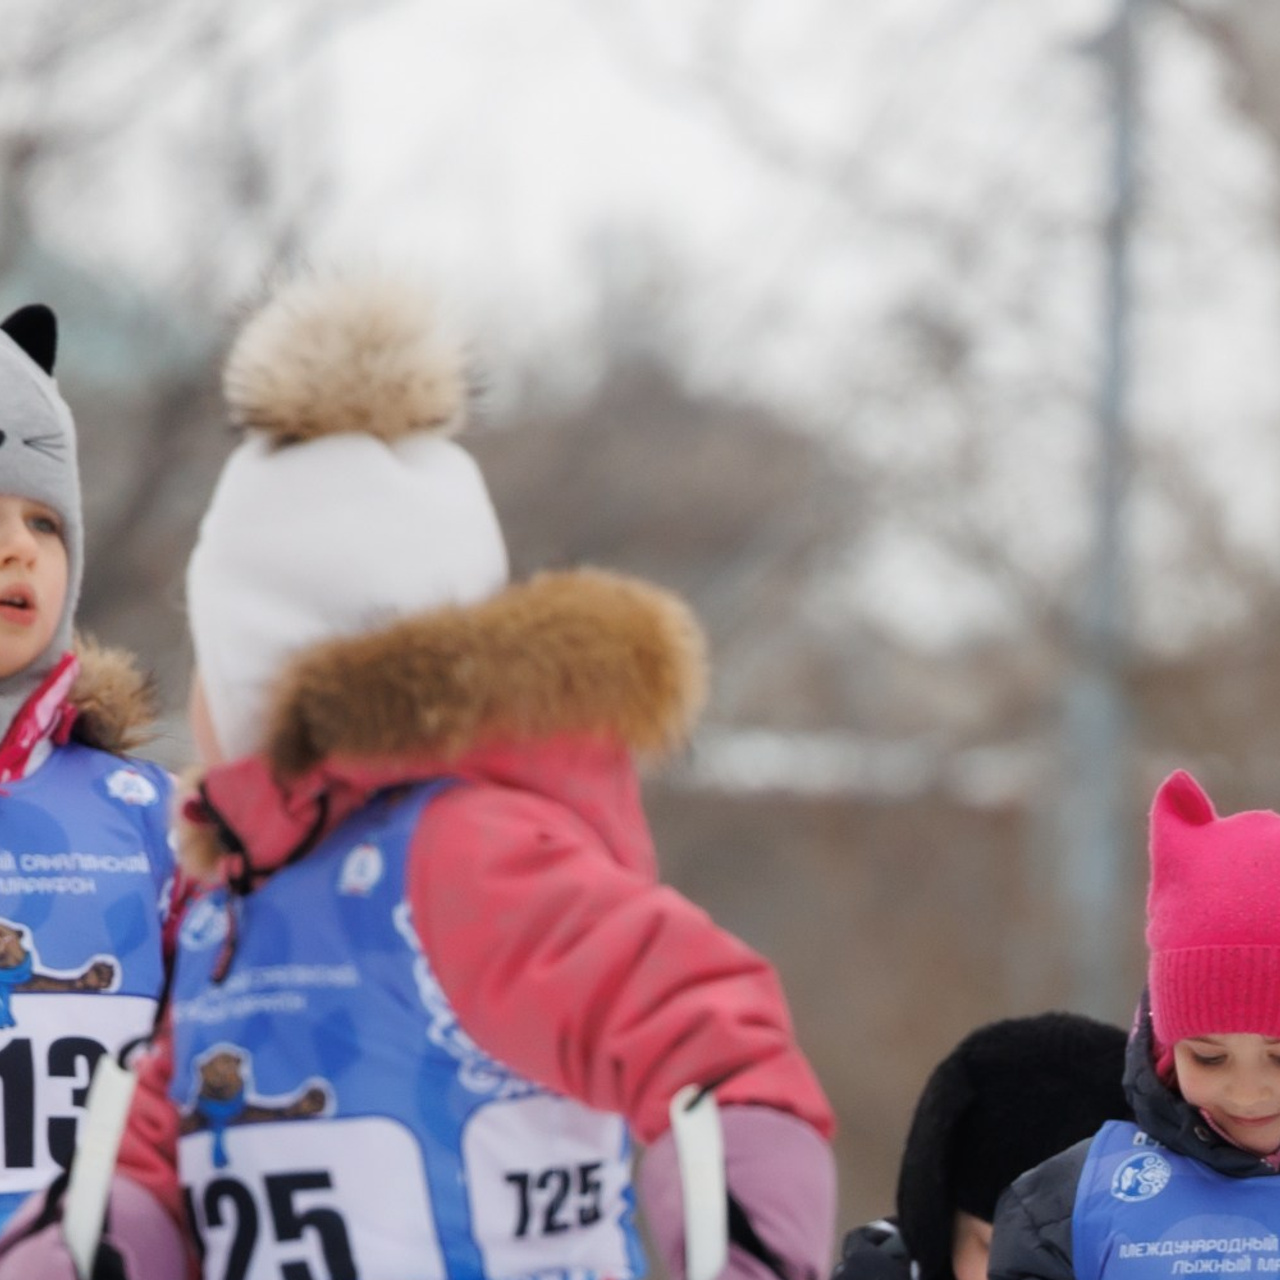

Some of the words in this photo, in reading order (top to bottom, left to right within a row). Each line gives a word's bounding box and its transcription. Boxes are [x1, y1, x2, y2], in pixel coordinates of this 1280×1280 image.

[505, 1161, 602, 1238] 725
[1119, 1235, 1279, 1259] МЕЖДУНАРОДНЫЙ
[1171, 1255, 1251, 1275] ЛЫЖНЫЙ
